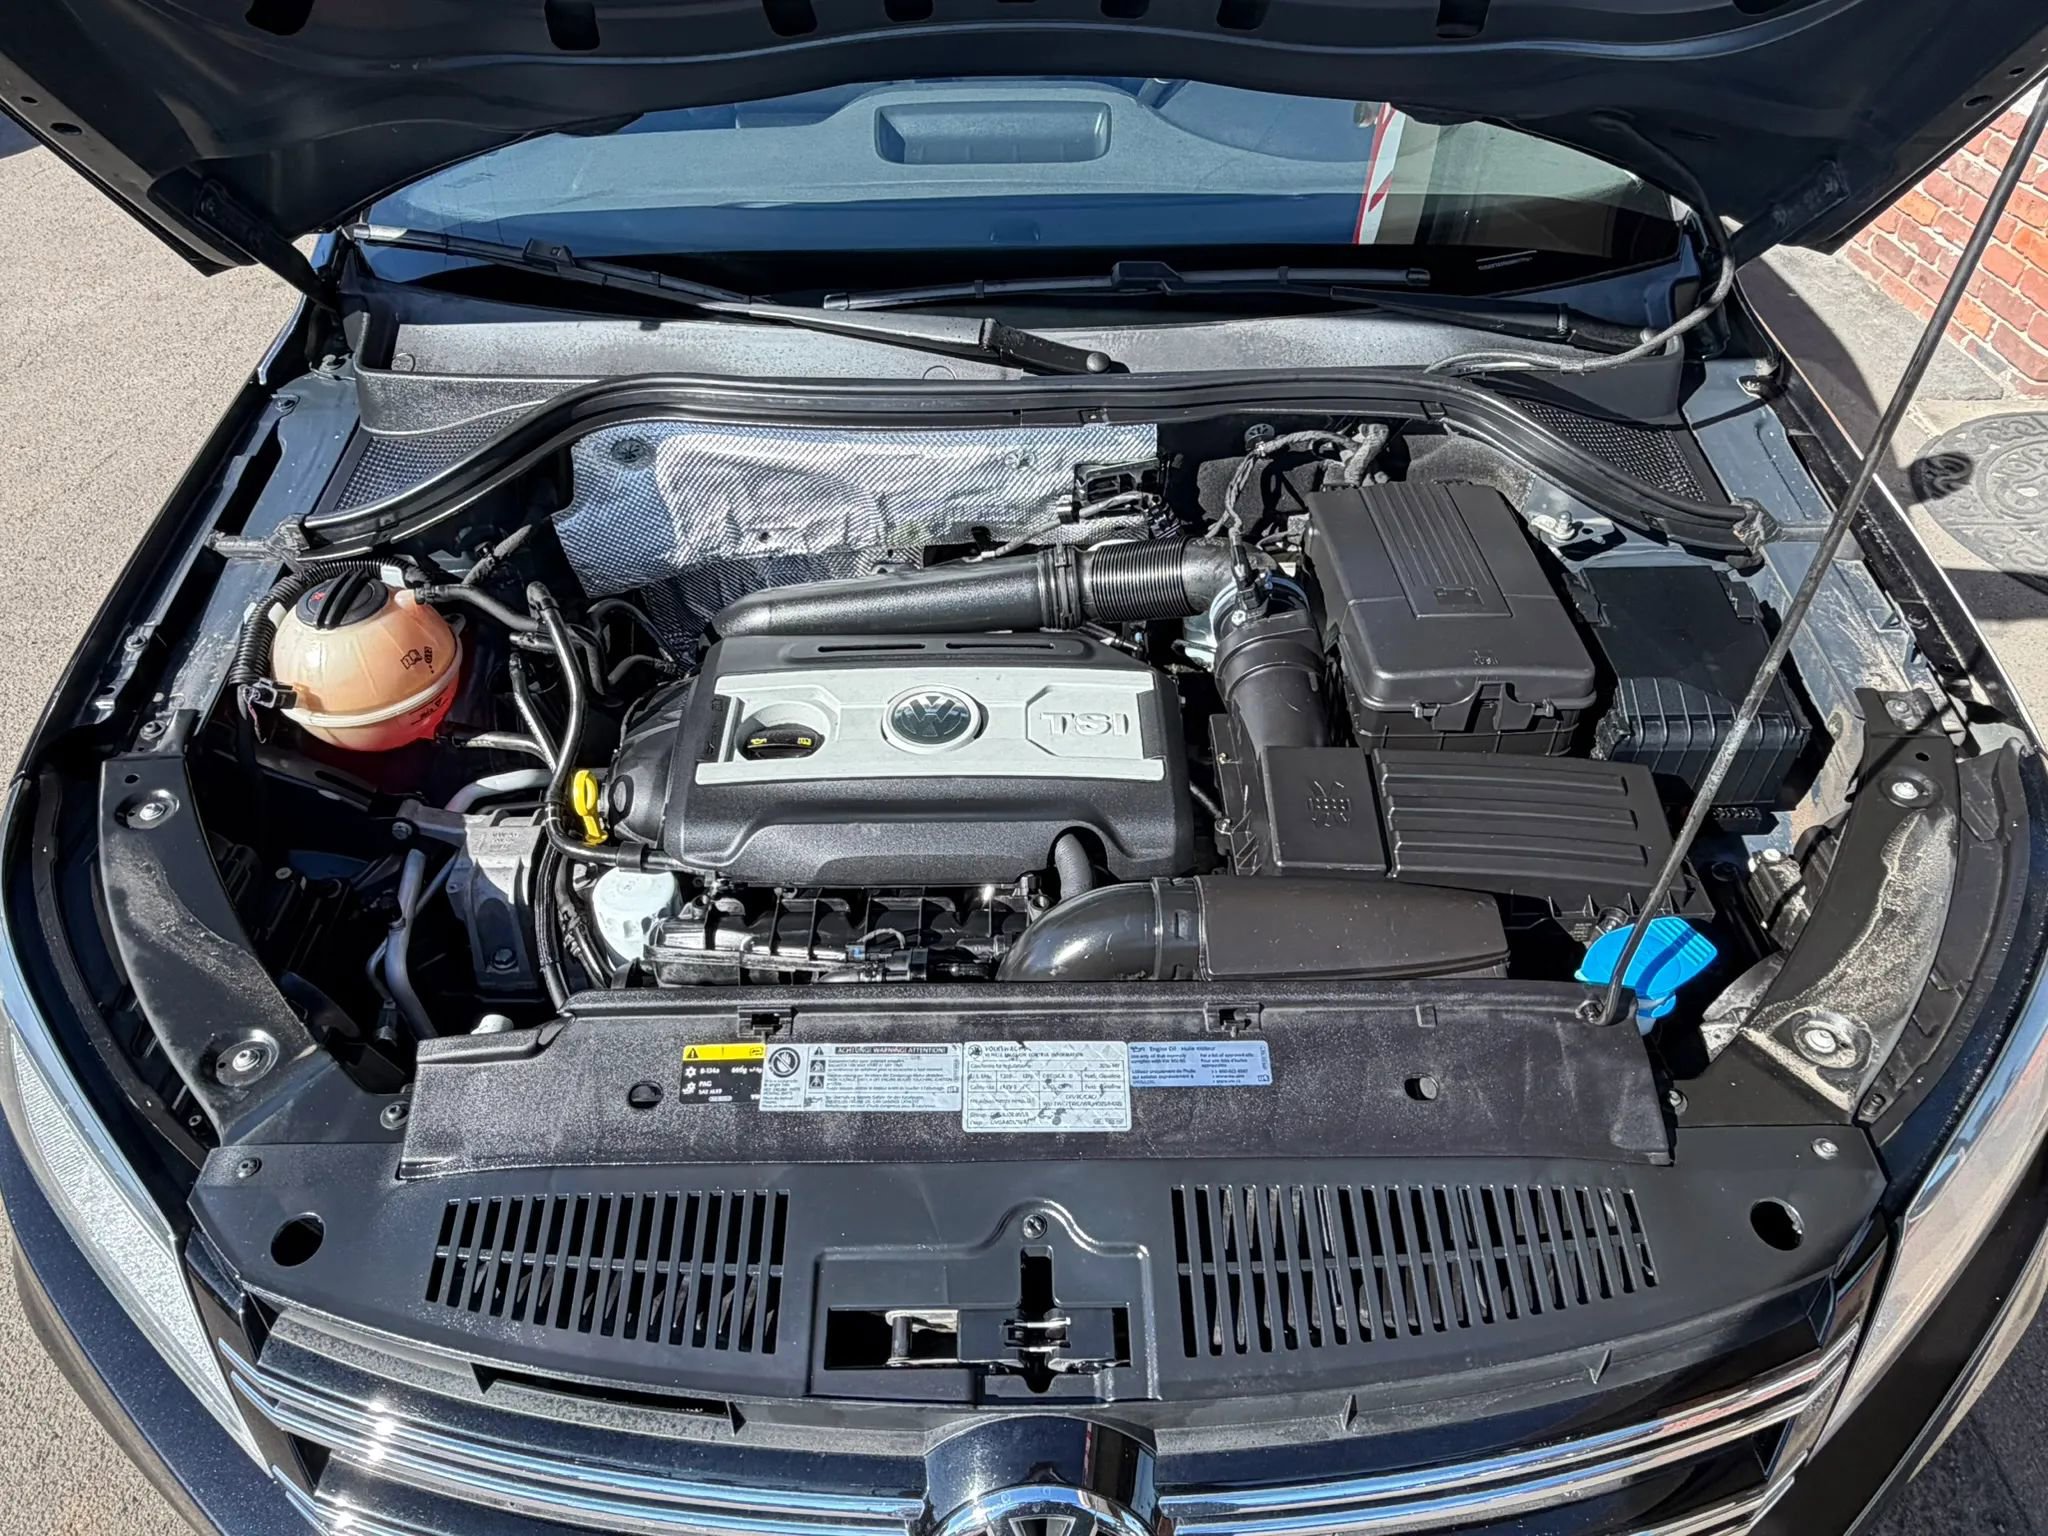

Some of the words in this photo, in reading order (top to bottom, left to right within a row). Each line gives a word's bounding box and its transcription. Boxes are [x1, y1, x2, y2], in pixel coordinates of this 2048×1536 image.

[1040, 711, 1130, 736] TSI
[872, 1046, 906, 1054] WARNING!
[907, 1046, 947, 1054] ATTENTION!
